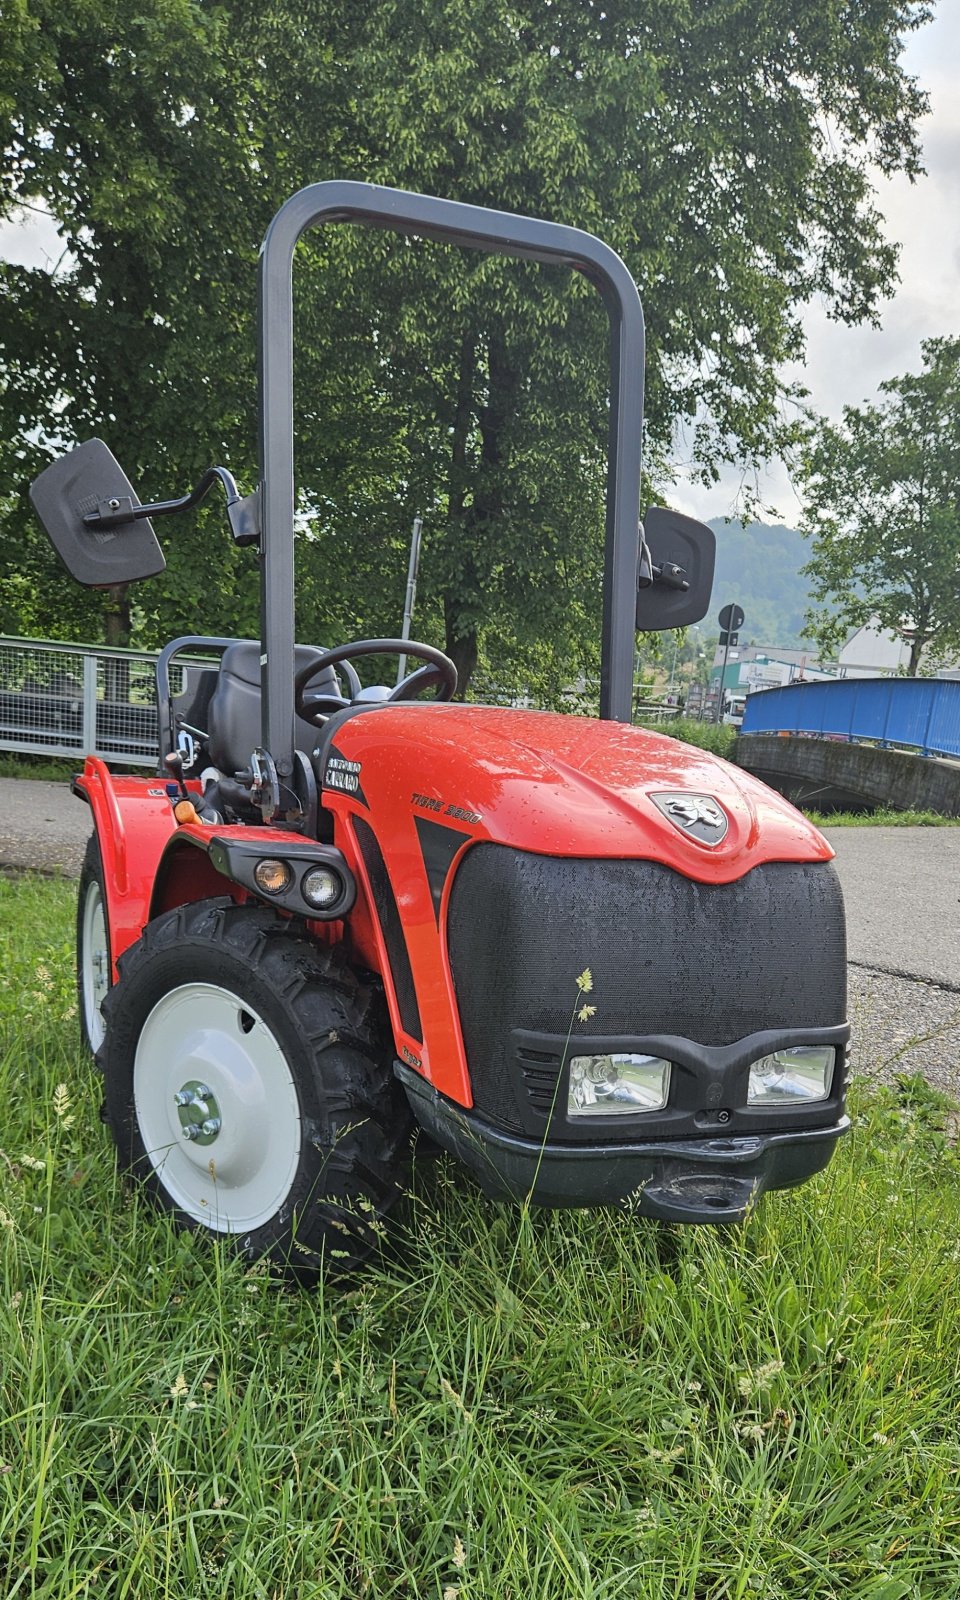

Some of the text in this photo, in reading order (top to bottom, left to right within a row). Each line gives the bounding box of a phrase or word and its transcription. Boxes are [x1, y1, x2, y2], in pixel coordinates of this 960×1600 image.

[328, 758, 361, 773] ANTONIO
[326, 770, 359, 792] CARRARO
[411, 793, 445, 812] TIGRE
